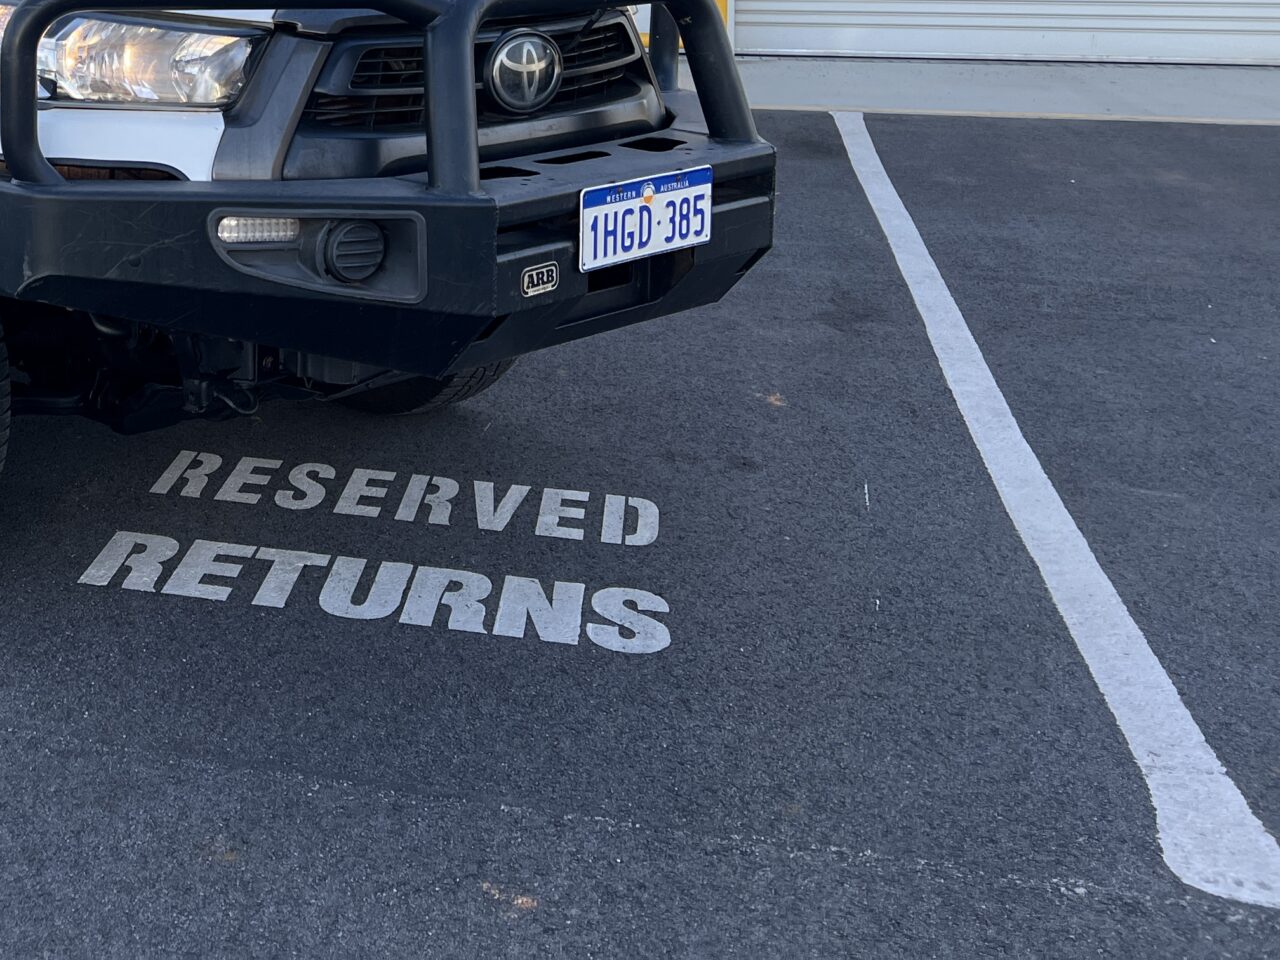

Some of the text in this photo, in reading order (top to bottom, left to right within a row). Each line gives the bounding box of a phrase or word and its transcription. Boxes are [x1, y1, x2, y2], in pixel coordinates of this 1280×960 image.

[606, 180, 690, 204] WESTERN AUSTRALIA
[525, 269, 555, 290] ARB
[149, 449, 660, 546] RESERVED
[77, 530, 672, 654] RETURNS
